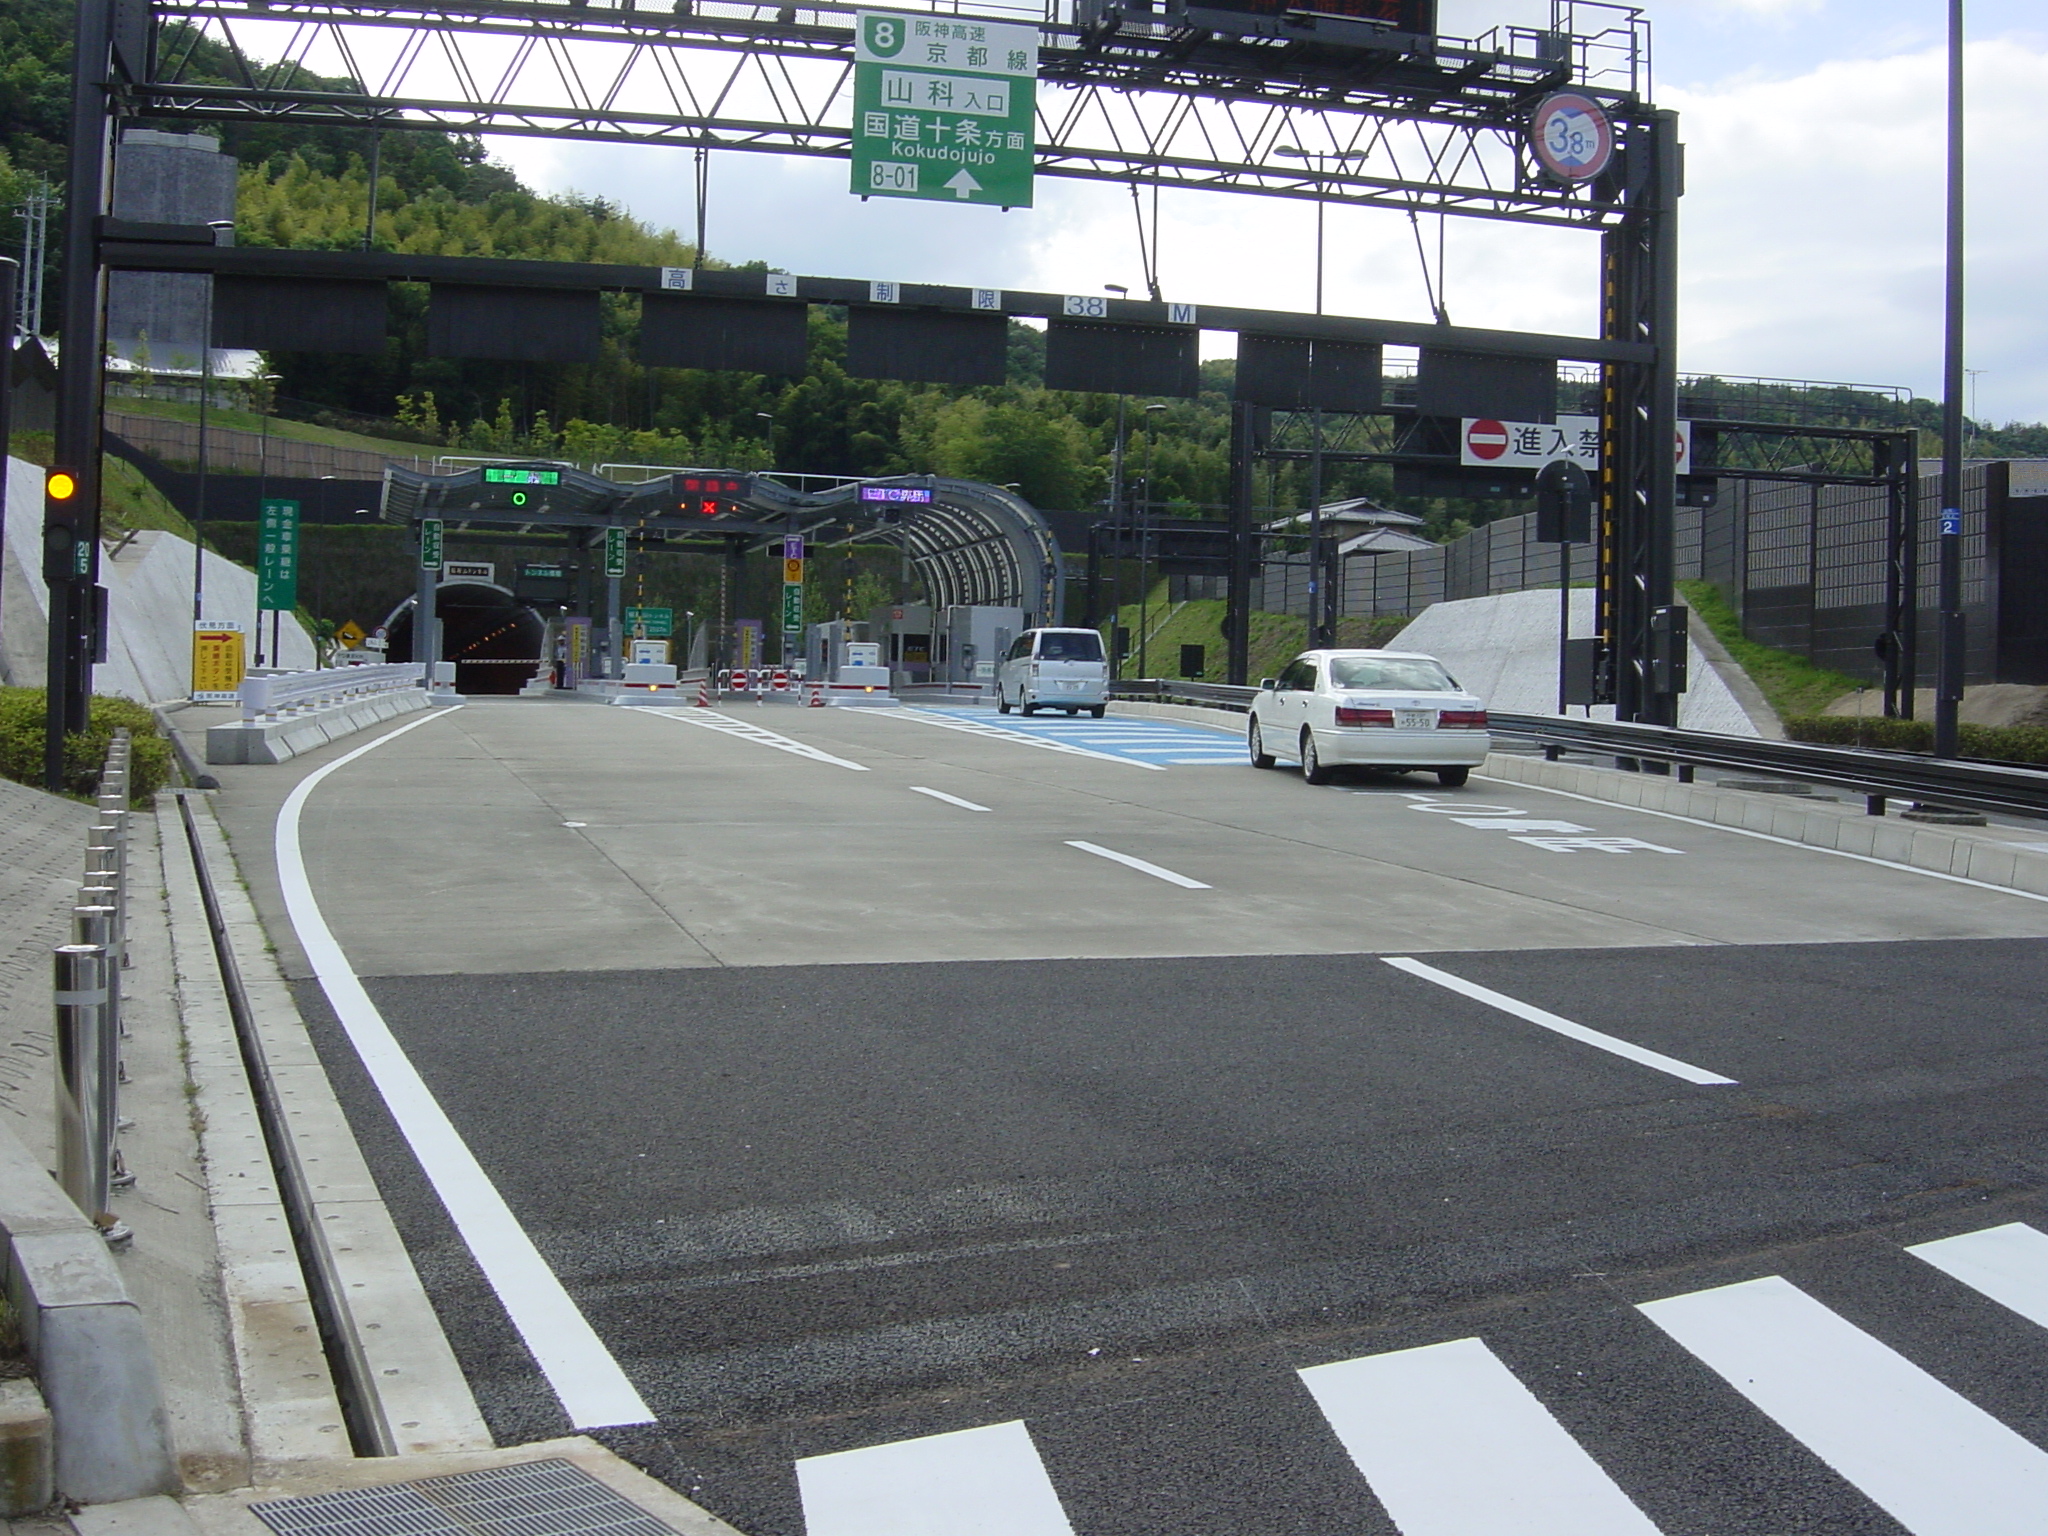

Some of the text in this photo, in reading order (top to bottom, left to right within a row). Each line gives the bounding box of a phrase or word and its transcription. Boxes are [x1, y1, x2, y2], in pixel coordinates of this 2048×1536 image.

[874, 21, 895, 48] 8
[914, 20, 986, 43] 阪神高速
[926, 42, 1028, 71] 京都線
[863, 111, 1026, 151] 国道十条方面
[891, 141, 996, 166] Kokudojujo
[872, 164, 915, 189] 8-01
[1513, 426, 1600, 459] 進入禁
[262, 505, 278, 604] 左側一般レーンへ
